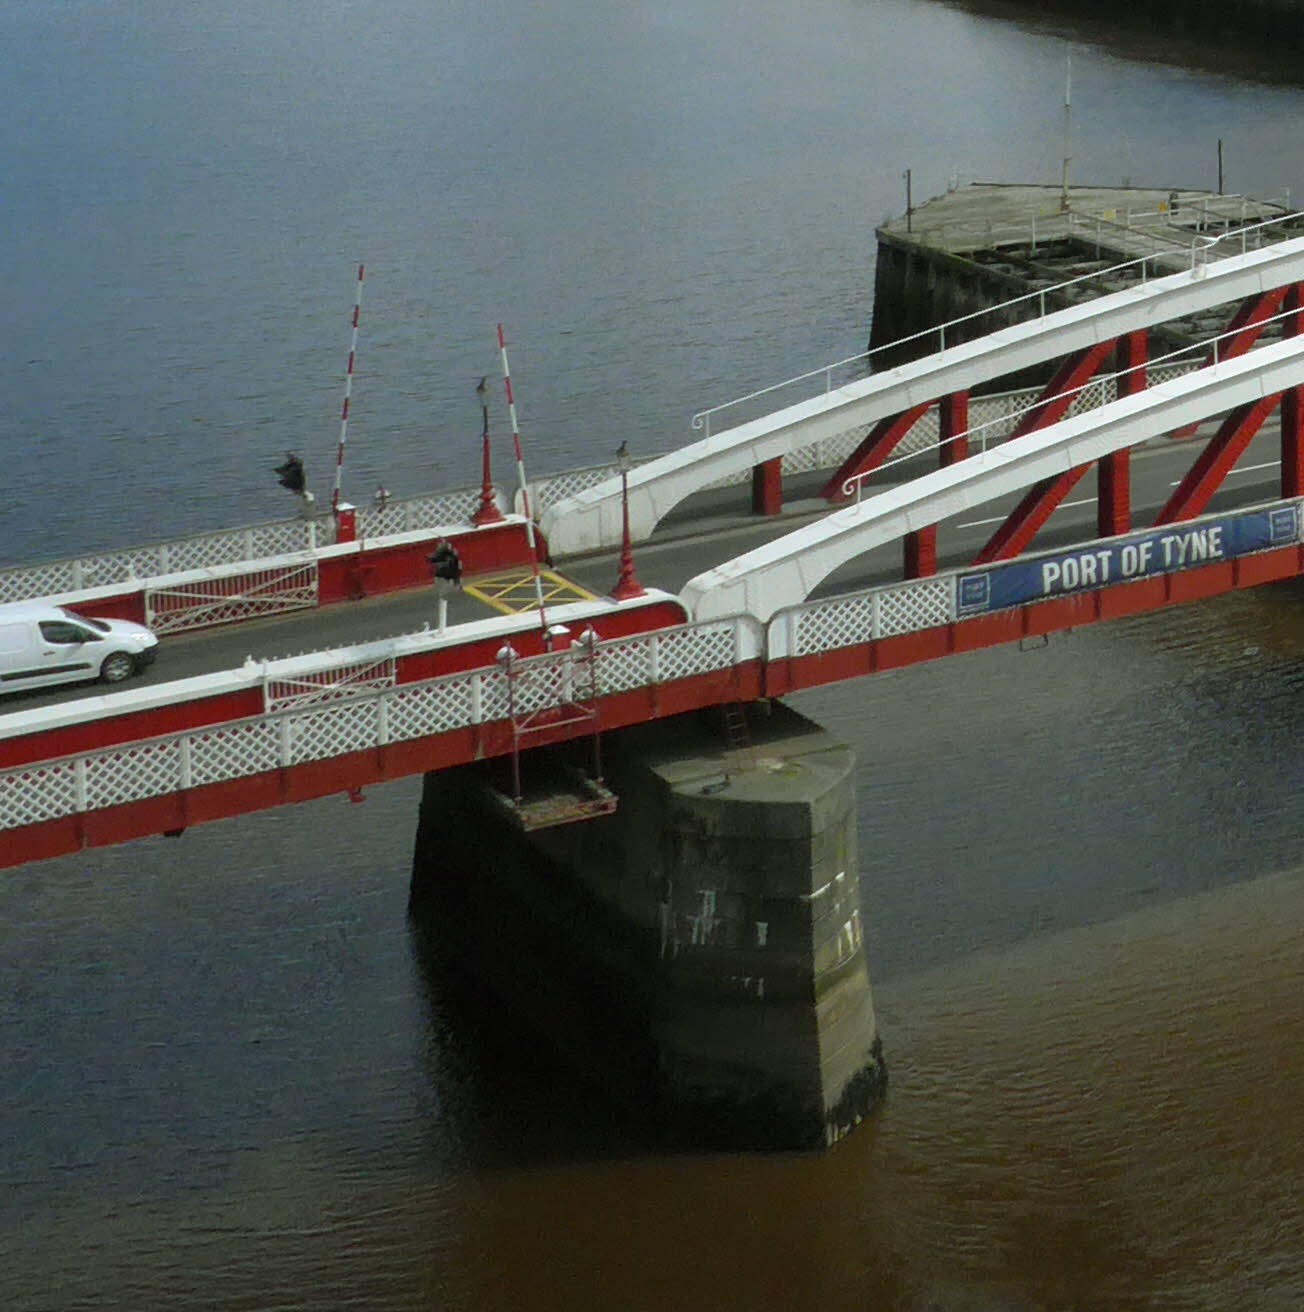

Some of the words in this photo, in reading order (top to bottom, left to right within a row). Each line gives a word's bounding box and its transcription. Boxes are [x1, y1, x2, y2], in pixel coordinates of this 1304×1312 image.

[1042, 550, 1113, 594] PORT
[1121, 541, 1153, 576] OF
[1161, 526, 1223, 566] TYNE
